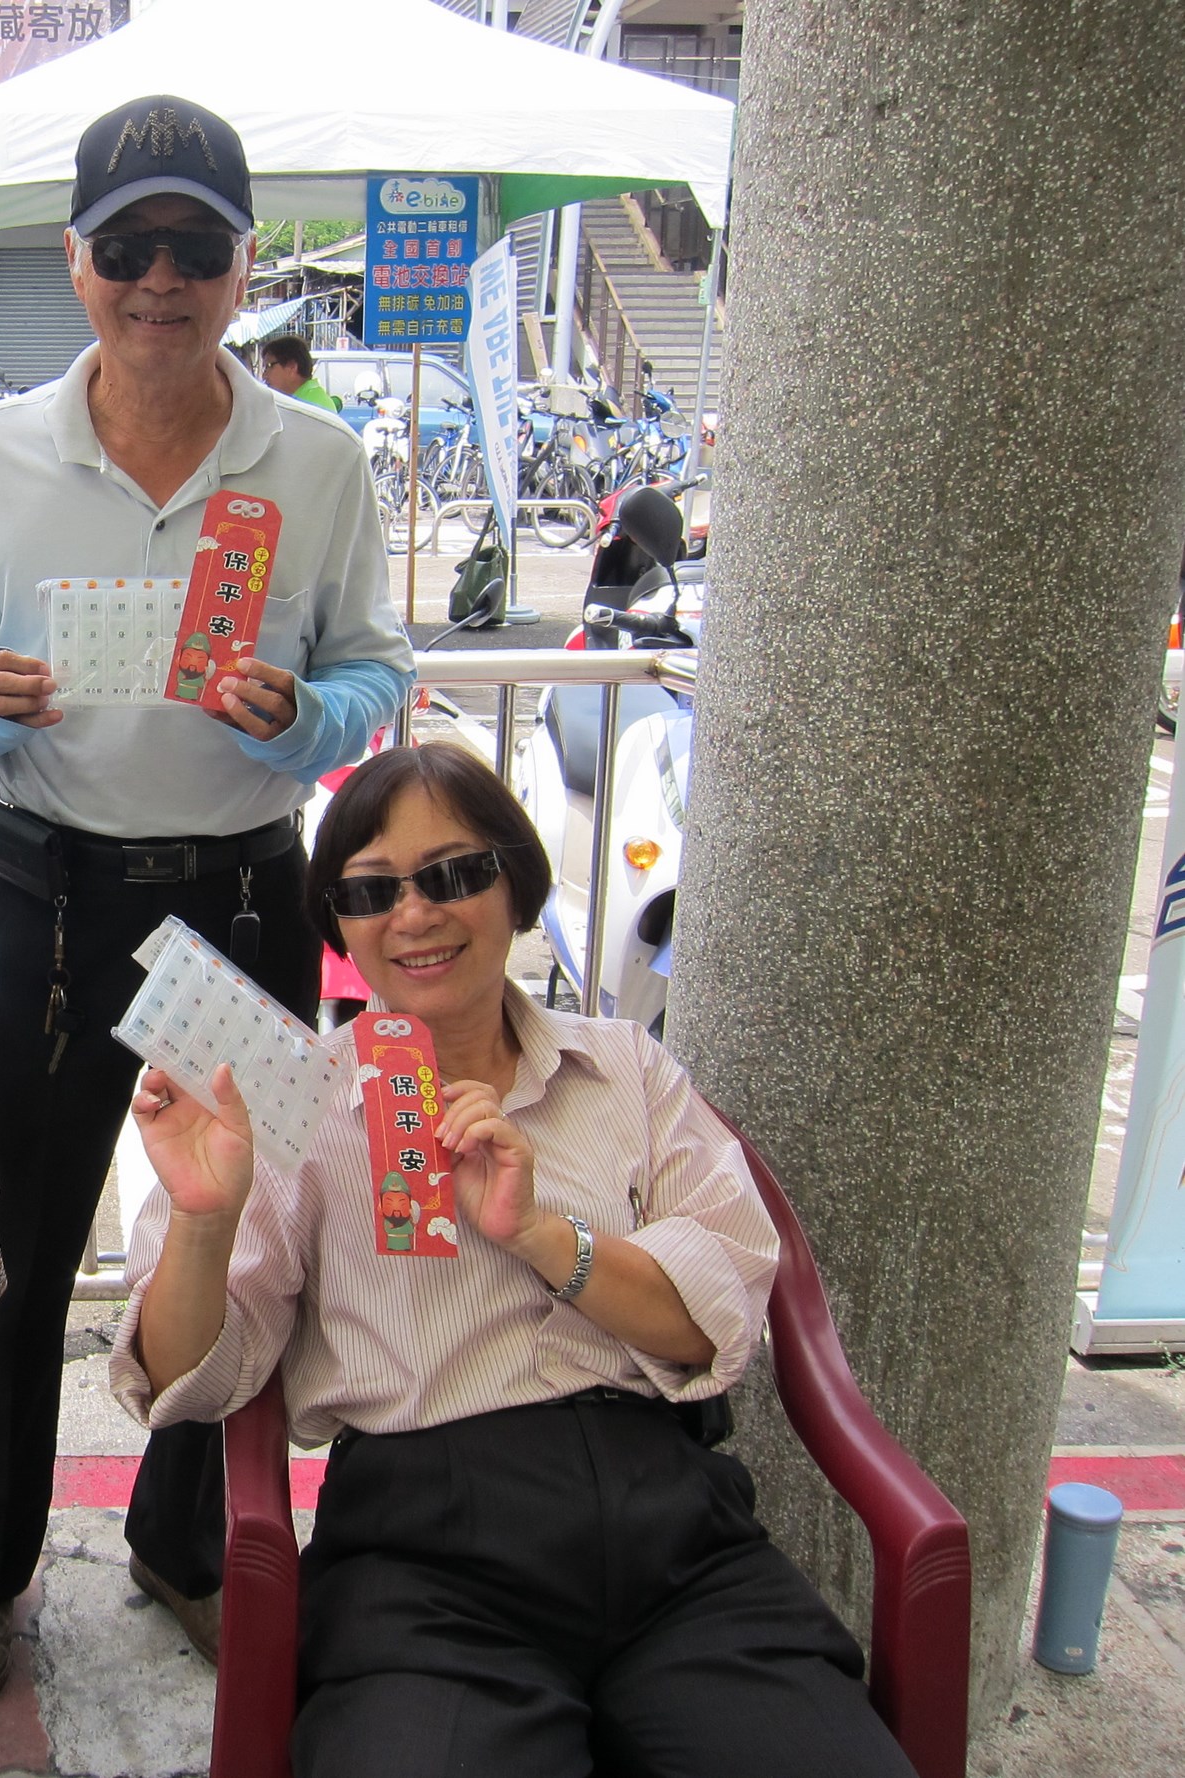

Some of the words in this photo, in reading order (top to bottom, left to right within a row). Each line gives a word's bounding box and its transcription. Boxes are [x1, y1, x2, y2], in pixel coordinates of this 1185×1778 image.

[377, 220, 468, 234] 公共電動二輪車租借
[383, 240, 462, 259] 全國首創
[372, 263, 470, 289] 電池交換站
[424, 294, 464, 311] 免加油
[378, 319, 463, 337] 無需自行充電
[248, 549, 269, 591] 平安符
[209, 550, 249, 637] 保平安
[419, 1066, 438, 1115] 平安符
[389, 1075, 426, 1172] 保平安
